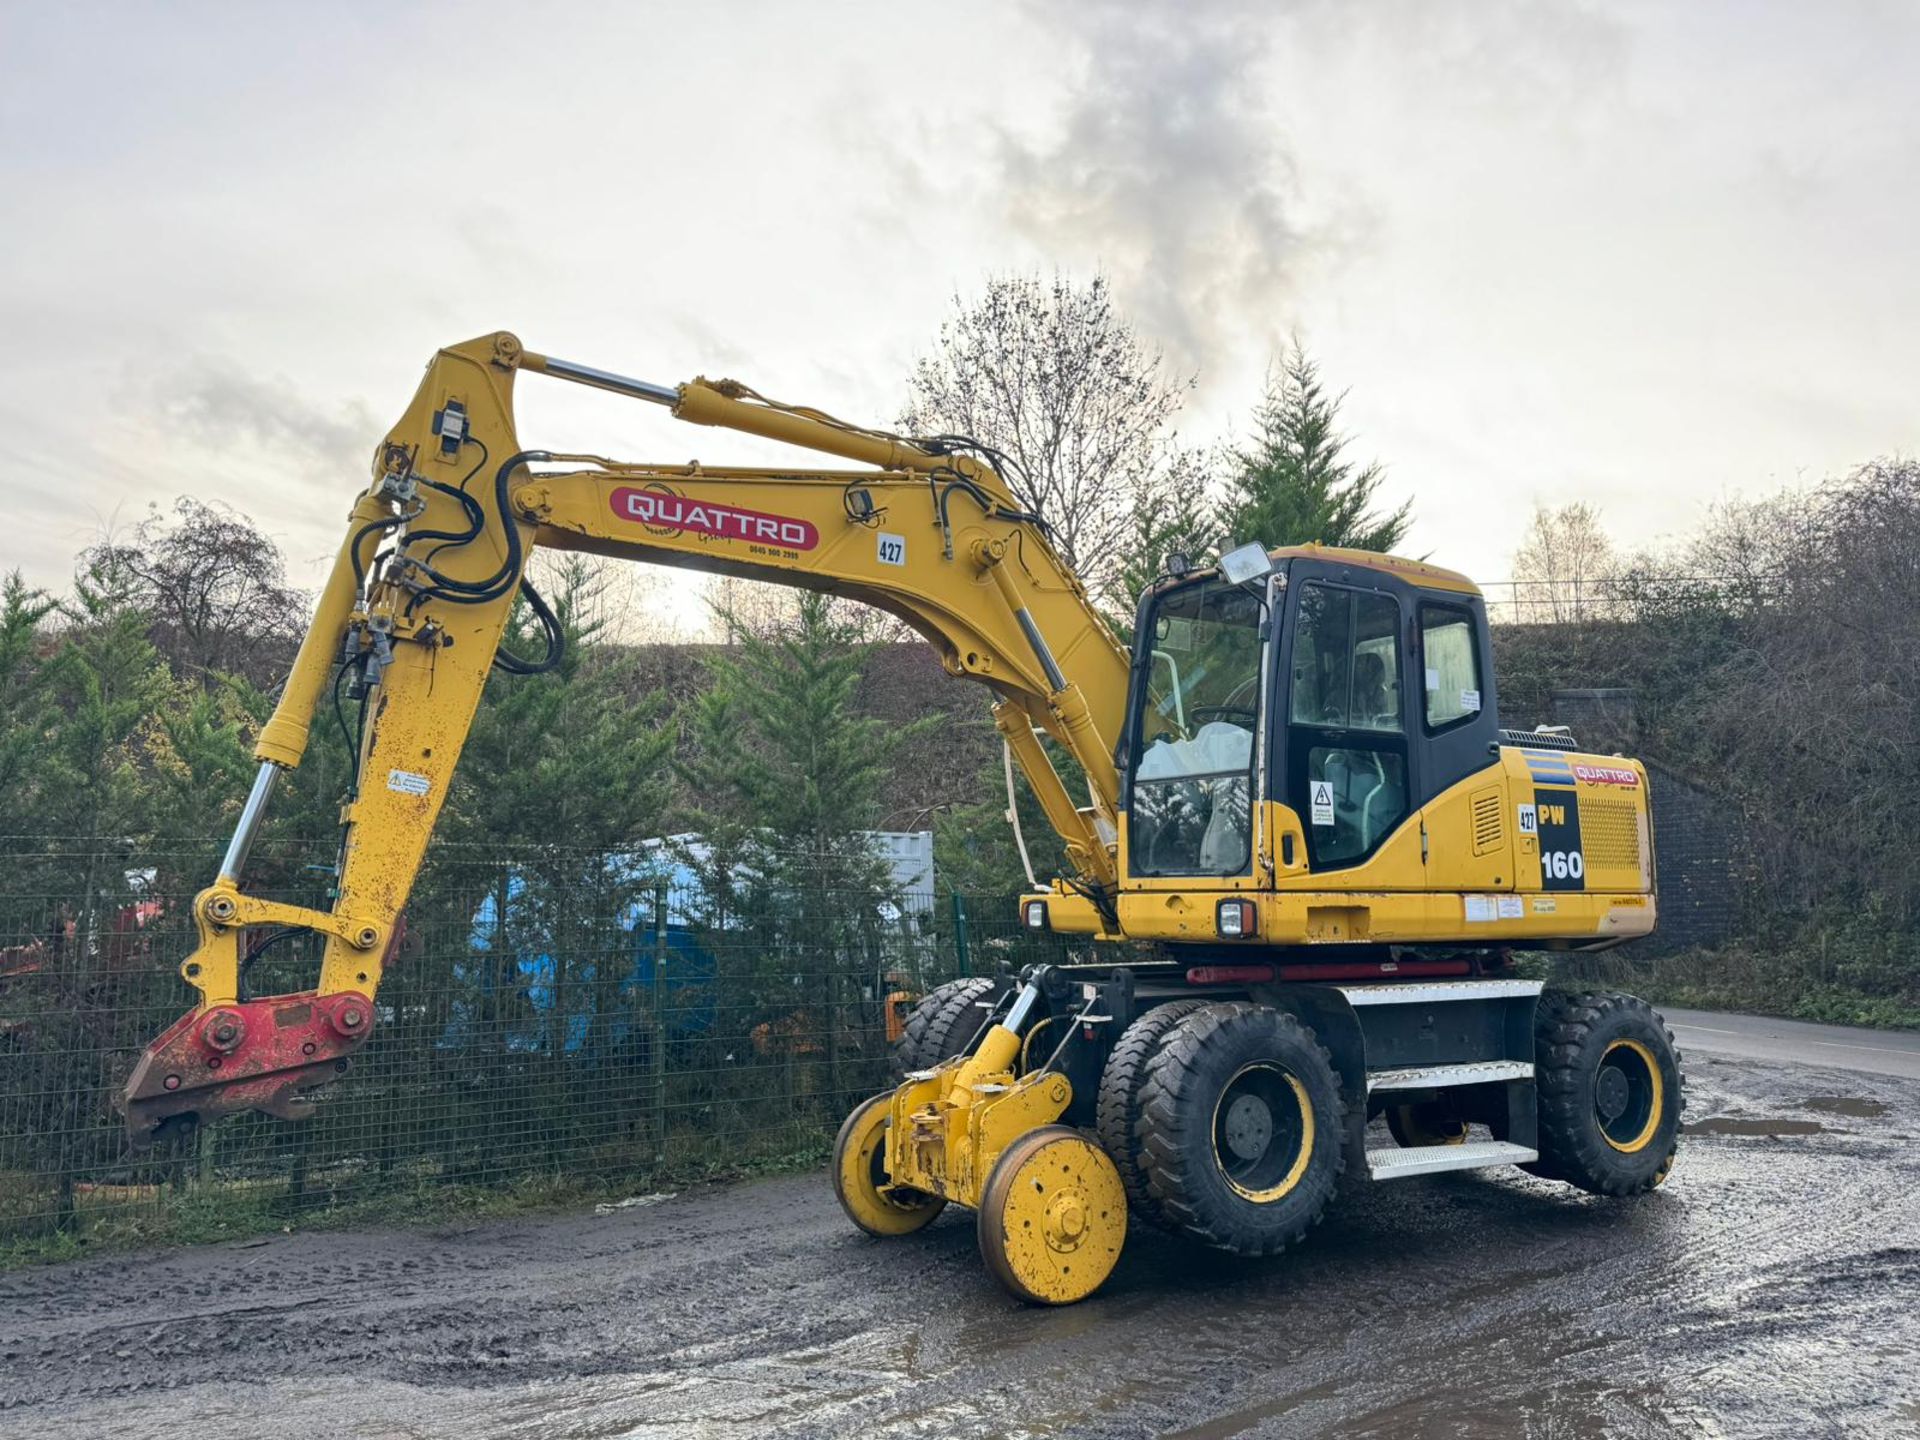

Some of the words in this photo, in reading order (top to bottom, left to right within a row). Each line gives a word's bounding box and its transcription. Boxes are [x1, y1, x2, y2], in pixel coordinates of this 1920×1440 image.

[627, 494, 805, 544] QUATTRO
[879, 541, 902, 563] 427
[1576, 766, 1635, 783] QUATTRO
[1521, 812, 1534, 830] 427
[1538, 804, 1565, 825] PW
[1541, 851, 1584, 879] 160
